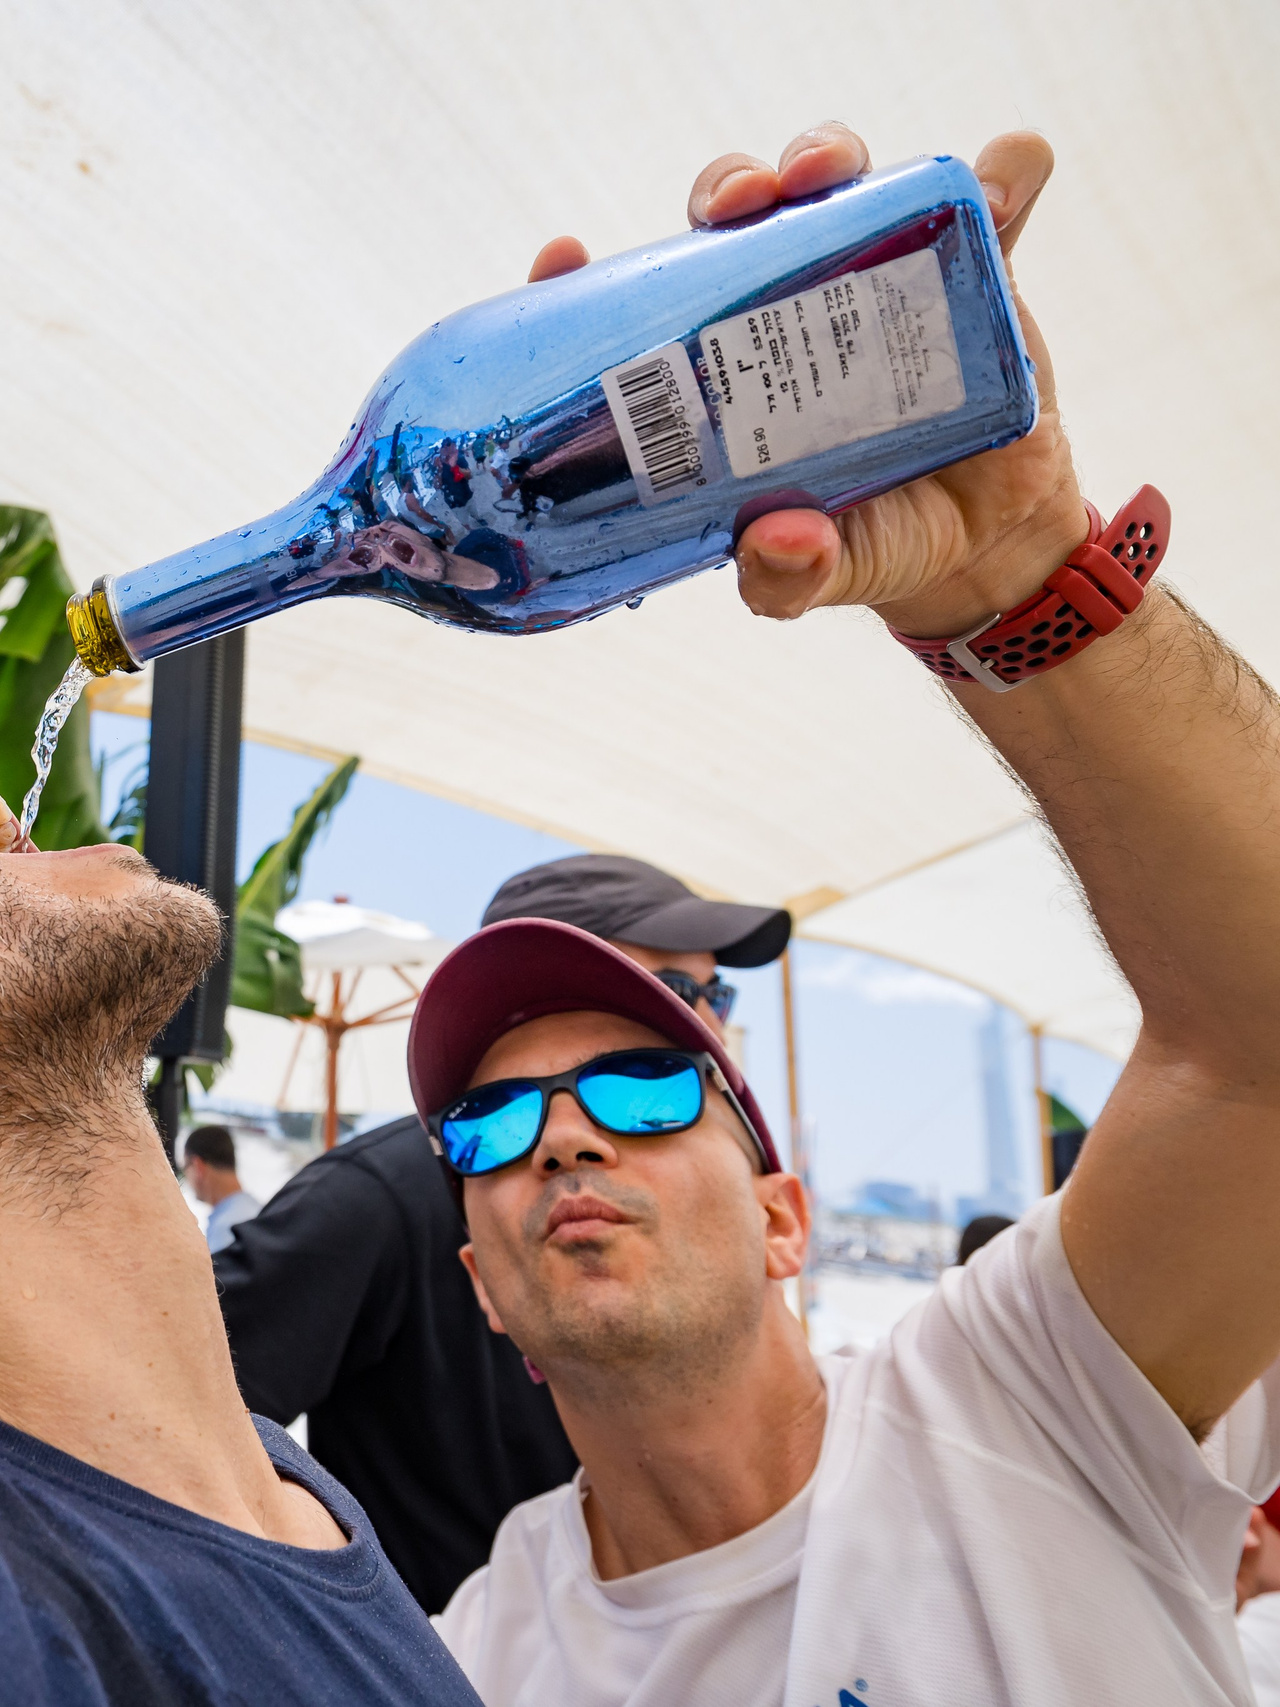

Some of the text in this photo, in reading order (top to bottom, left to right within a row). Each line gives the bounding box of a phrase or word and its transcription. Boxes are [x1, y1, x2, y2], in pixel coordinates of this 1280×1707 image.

[709, 337, 733, 404] 44591038
[761, 372, 772, 388] 100
[753, 427, 771, 464] $26.90
[696, 477, 707, 487] 8
